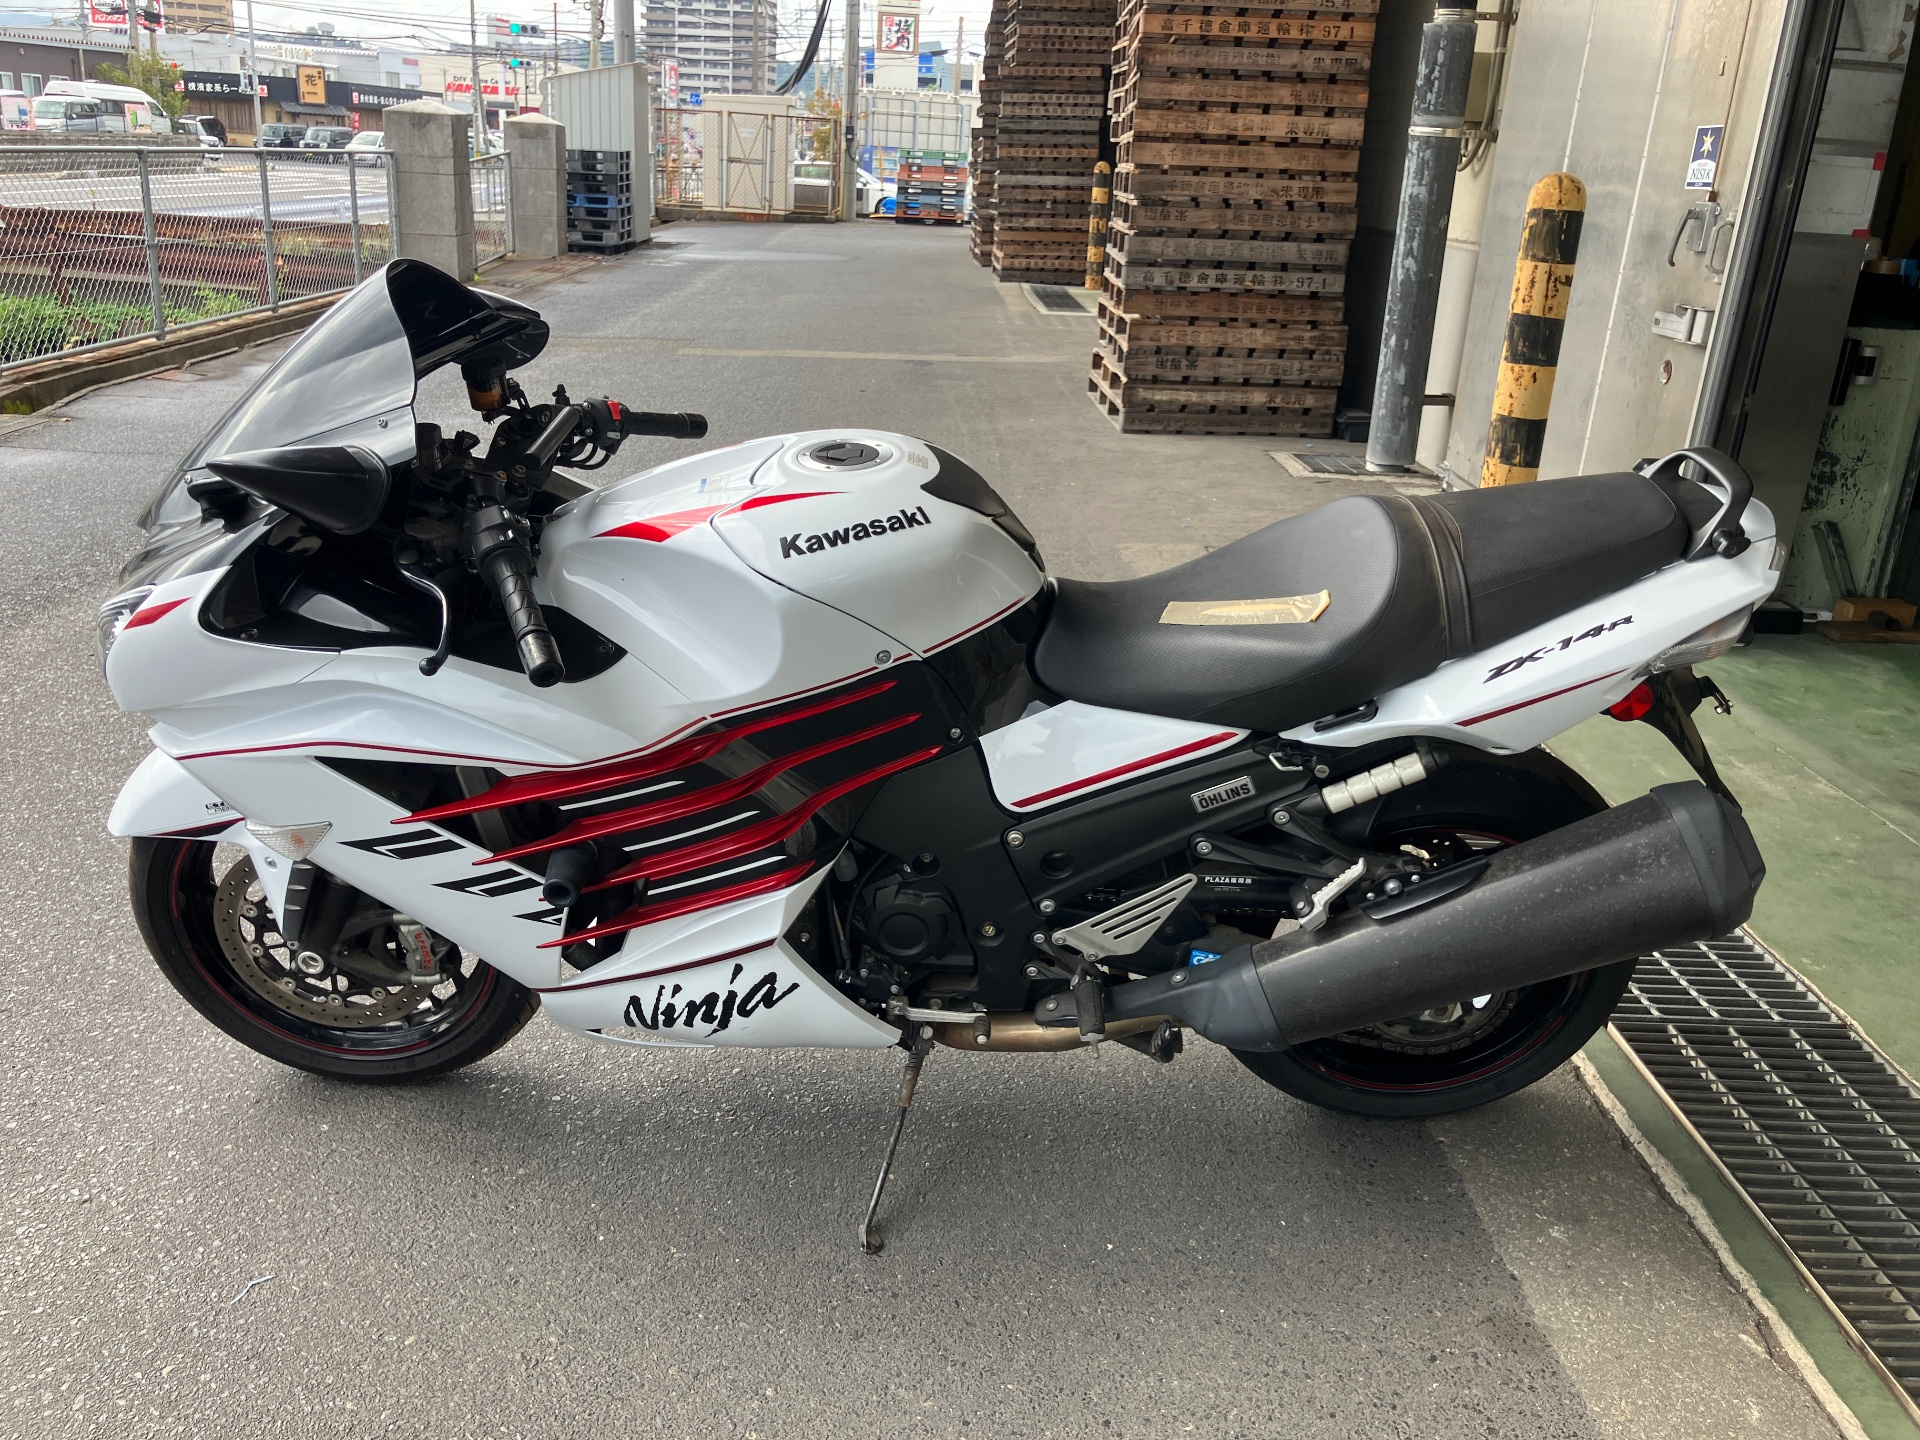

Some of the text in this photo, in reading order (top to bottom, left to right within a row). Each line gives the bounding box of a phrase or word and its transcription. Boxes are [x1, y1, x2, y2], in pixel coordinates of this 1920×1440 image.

[1322, 25, 1355, 39] 97.1
[1296, 276, 1328, 290] 97.1
[779, 506, 931, 559] Kawasaki
[1198, 783, 1251, 809] ÖHLINS
[623, 963, 800, 1038] Ninja
